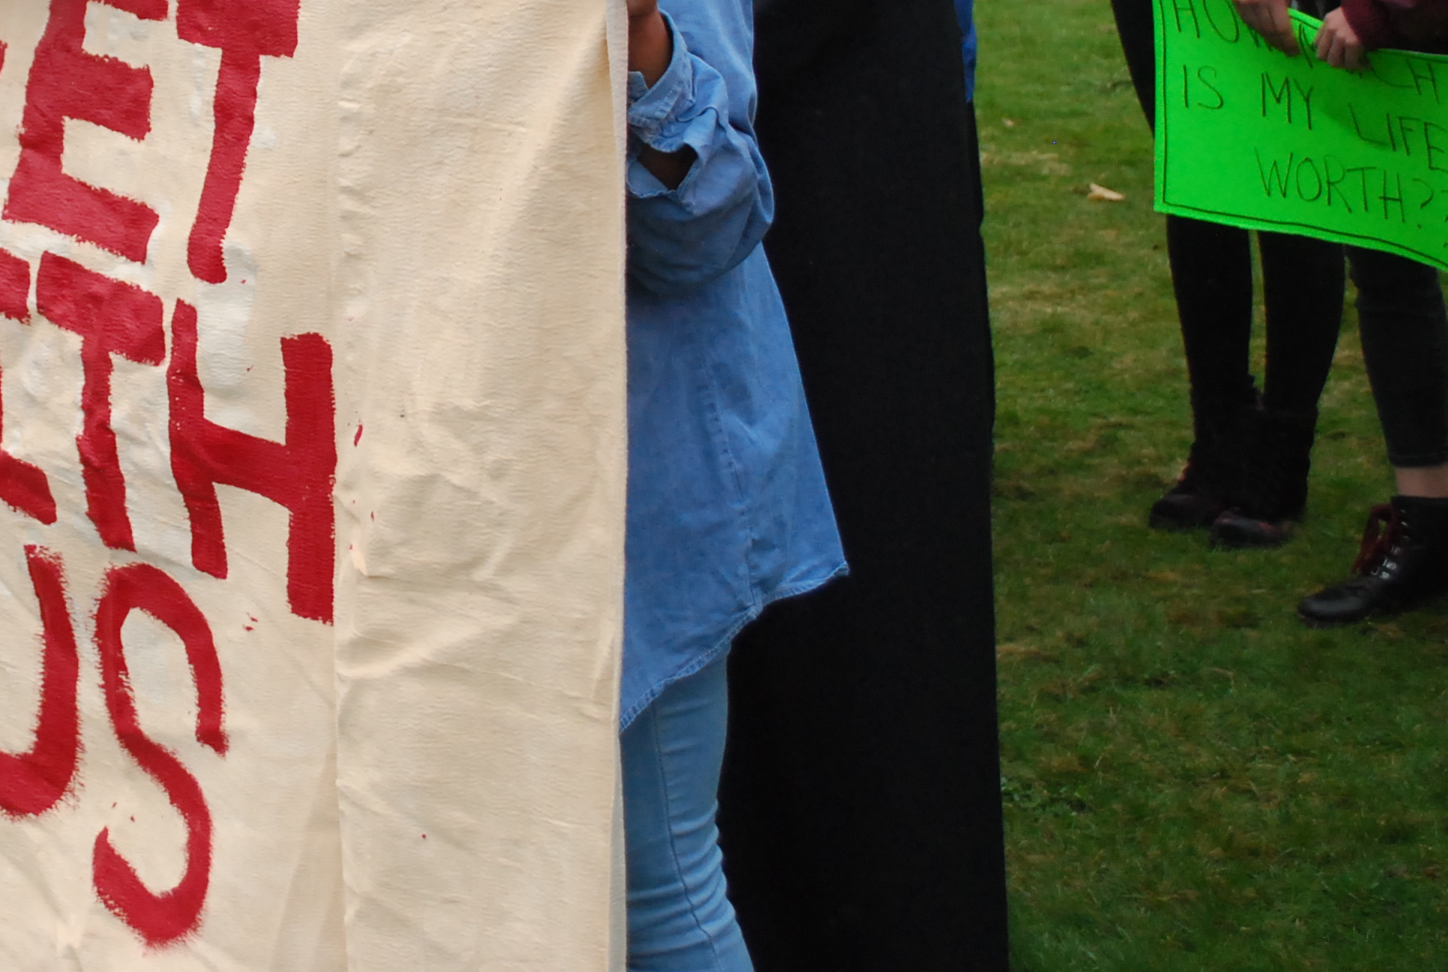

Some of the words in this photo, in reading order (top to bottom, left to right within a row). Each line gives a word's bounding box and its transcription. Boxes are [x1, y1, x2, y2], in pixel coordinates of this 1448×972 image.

[1182, 63, 1225, 110] IS
[1261, 72, 1315, 130] MY
[1348, 101, 1448, 171] LIFE
